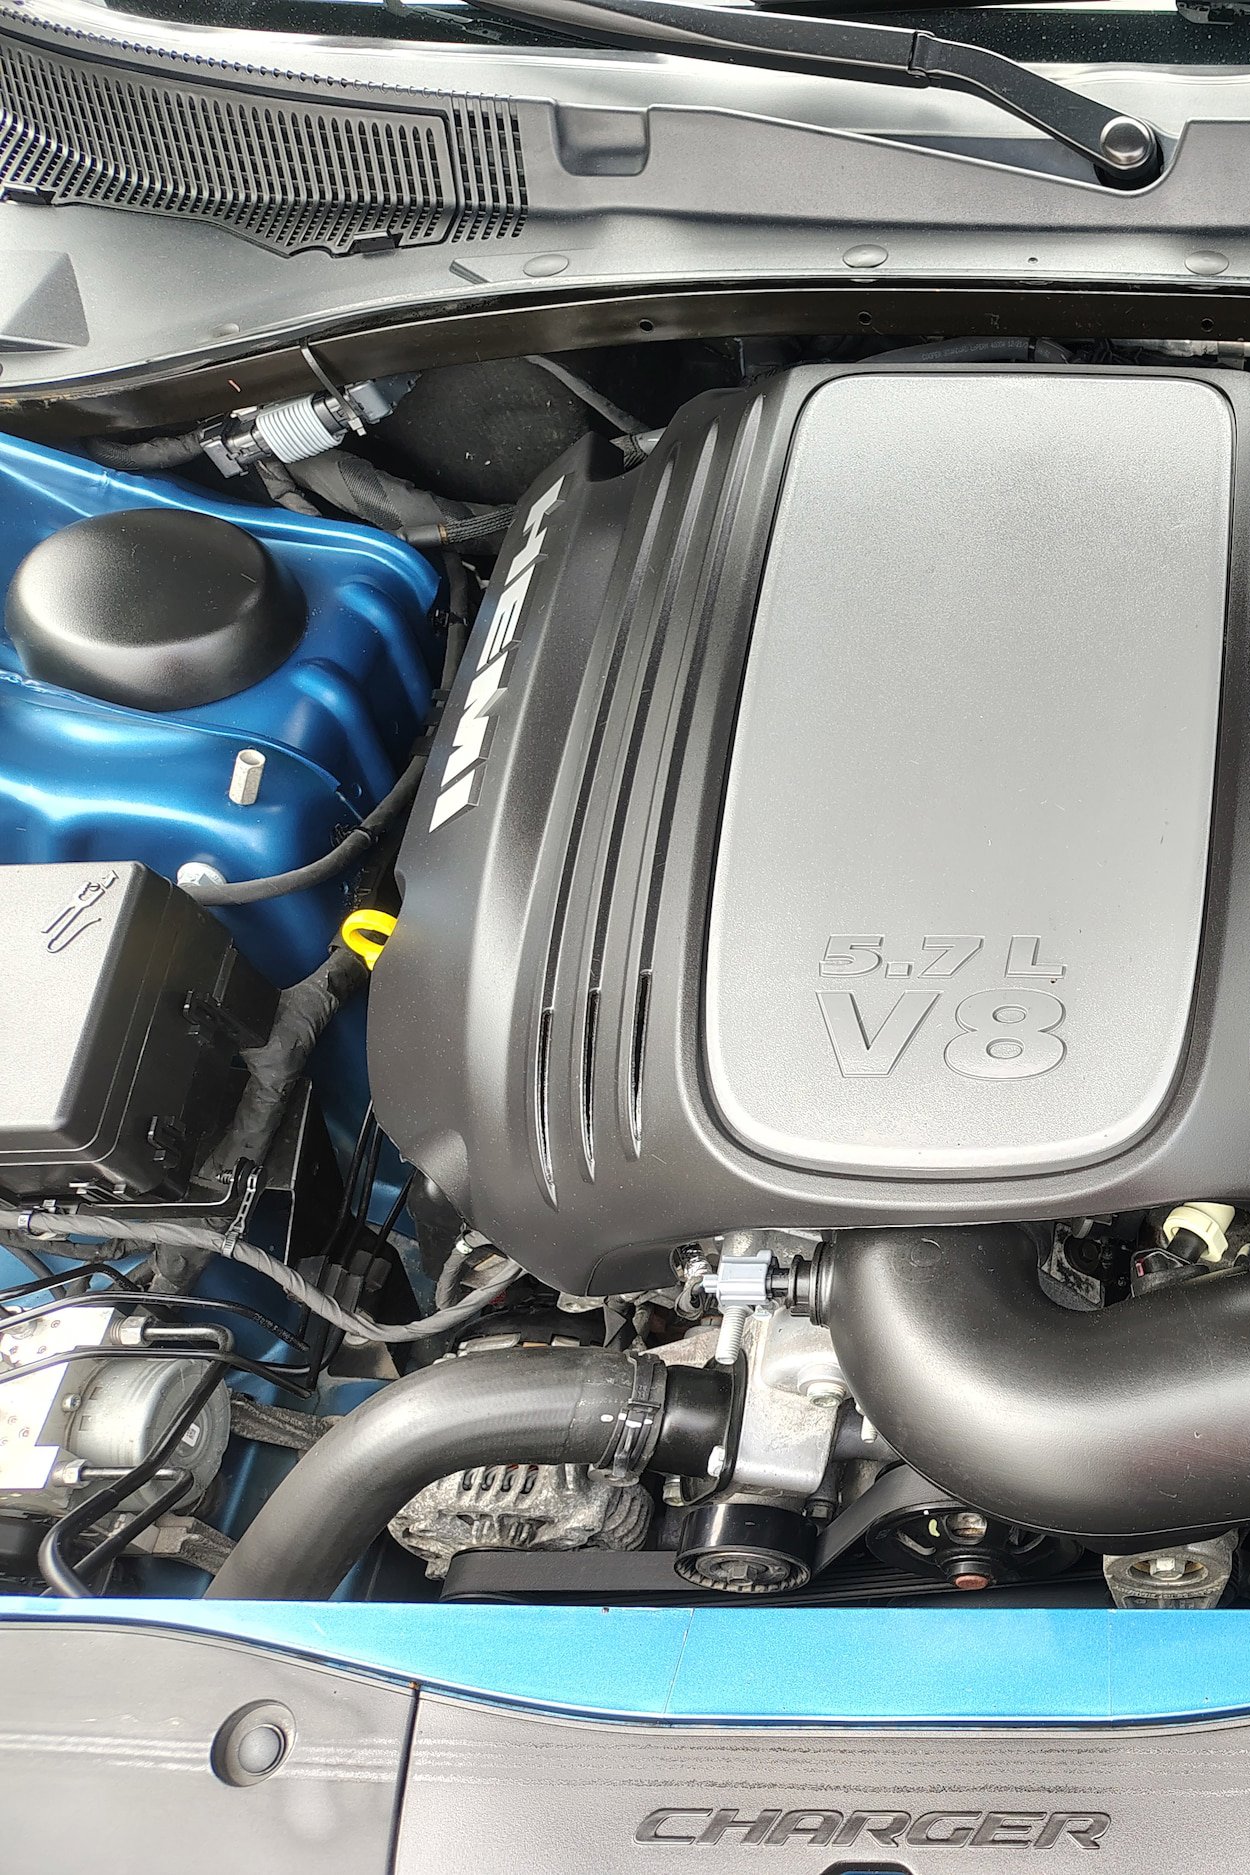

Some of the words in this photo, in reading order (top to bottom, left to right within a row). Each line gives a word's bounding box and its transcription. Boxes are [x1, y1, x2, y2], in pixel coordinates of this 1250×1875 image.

[428, 473, 567, 833] HEMI
[818, 933, 985, 979] 5.7
[1004, 935, 1067, 979] L
[816, 988, 1068, 1081] V8
[633, 1807, 1112, 1850] CHARGER
